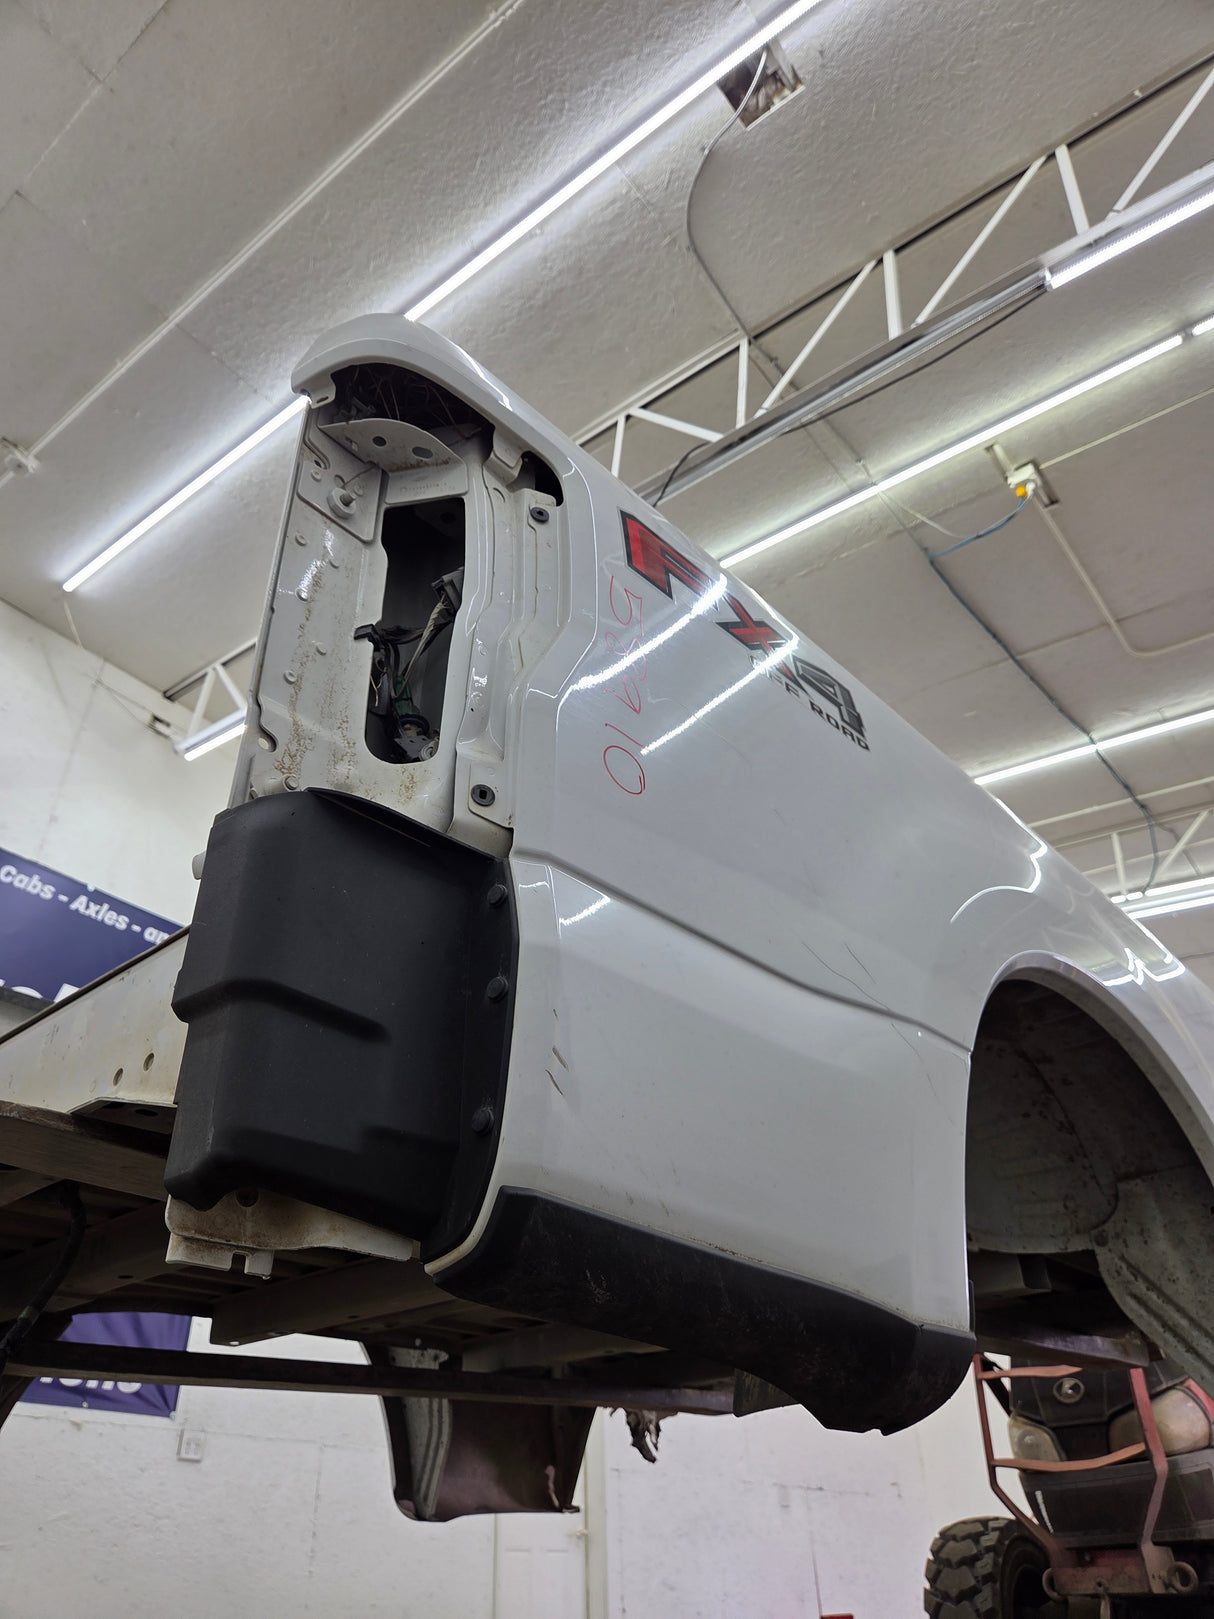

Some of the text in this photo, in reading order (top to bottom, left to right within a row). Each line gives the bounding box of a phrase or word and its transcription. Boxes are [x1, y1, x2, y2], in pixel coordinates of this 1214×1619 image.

[618, 507, 867, 741] FX4
[808, 699, 871, 751] ROAD
[0, 864, 56, 900] Cabs
[69, 894, 130, 931] Axles
